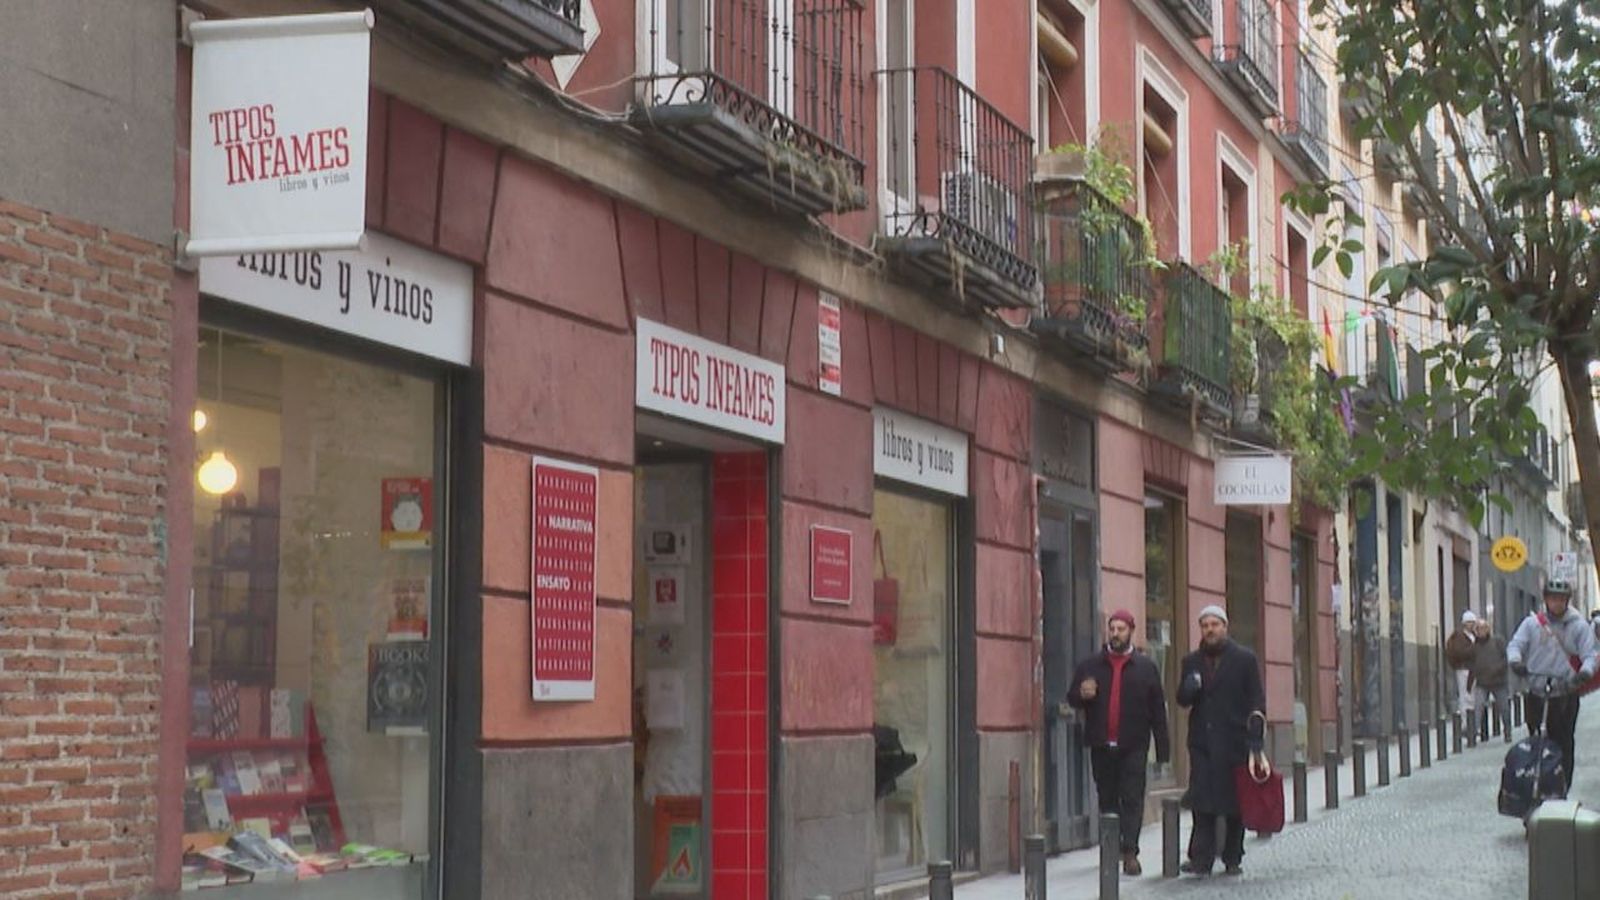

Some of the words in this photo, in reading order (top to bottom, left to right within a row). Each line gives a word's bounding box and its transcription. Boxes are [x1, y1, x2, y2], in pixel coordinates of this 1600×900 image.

[208, 103, 276, 147] TIPOS
[224, 127, 350, 186] INFAMES
[312, 177, 319, 191] y
[323, 171, 350, 186] vinos
[338, 259, 352, 315] y
[366, 256, 434, 325] vinos
[651, 336, 701, 406] TIPOS
[705, 355, 775, 427] INFAMES
[881, 415, 914, 463] libros
[917, 441, 924, 475] y
[928, 435, 954, 475] vinos
[548, 515, 594, 534] NARRATIVA
[536, 573, 571, 591] ENSAYO
